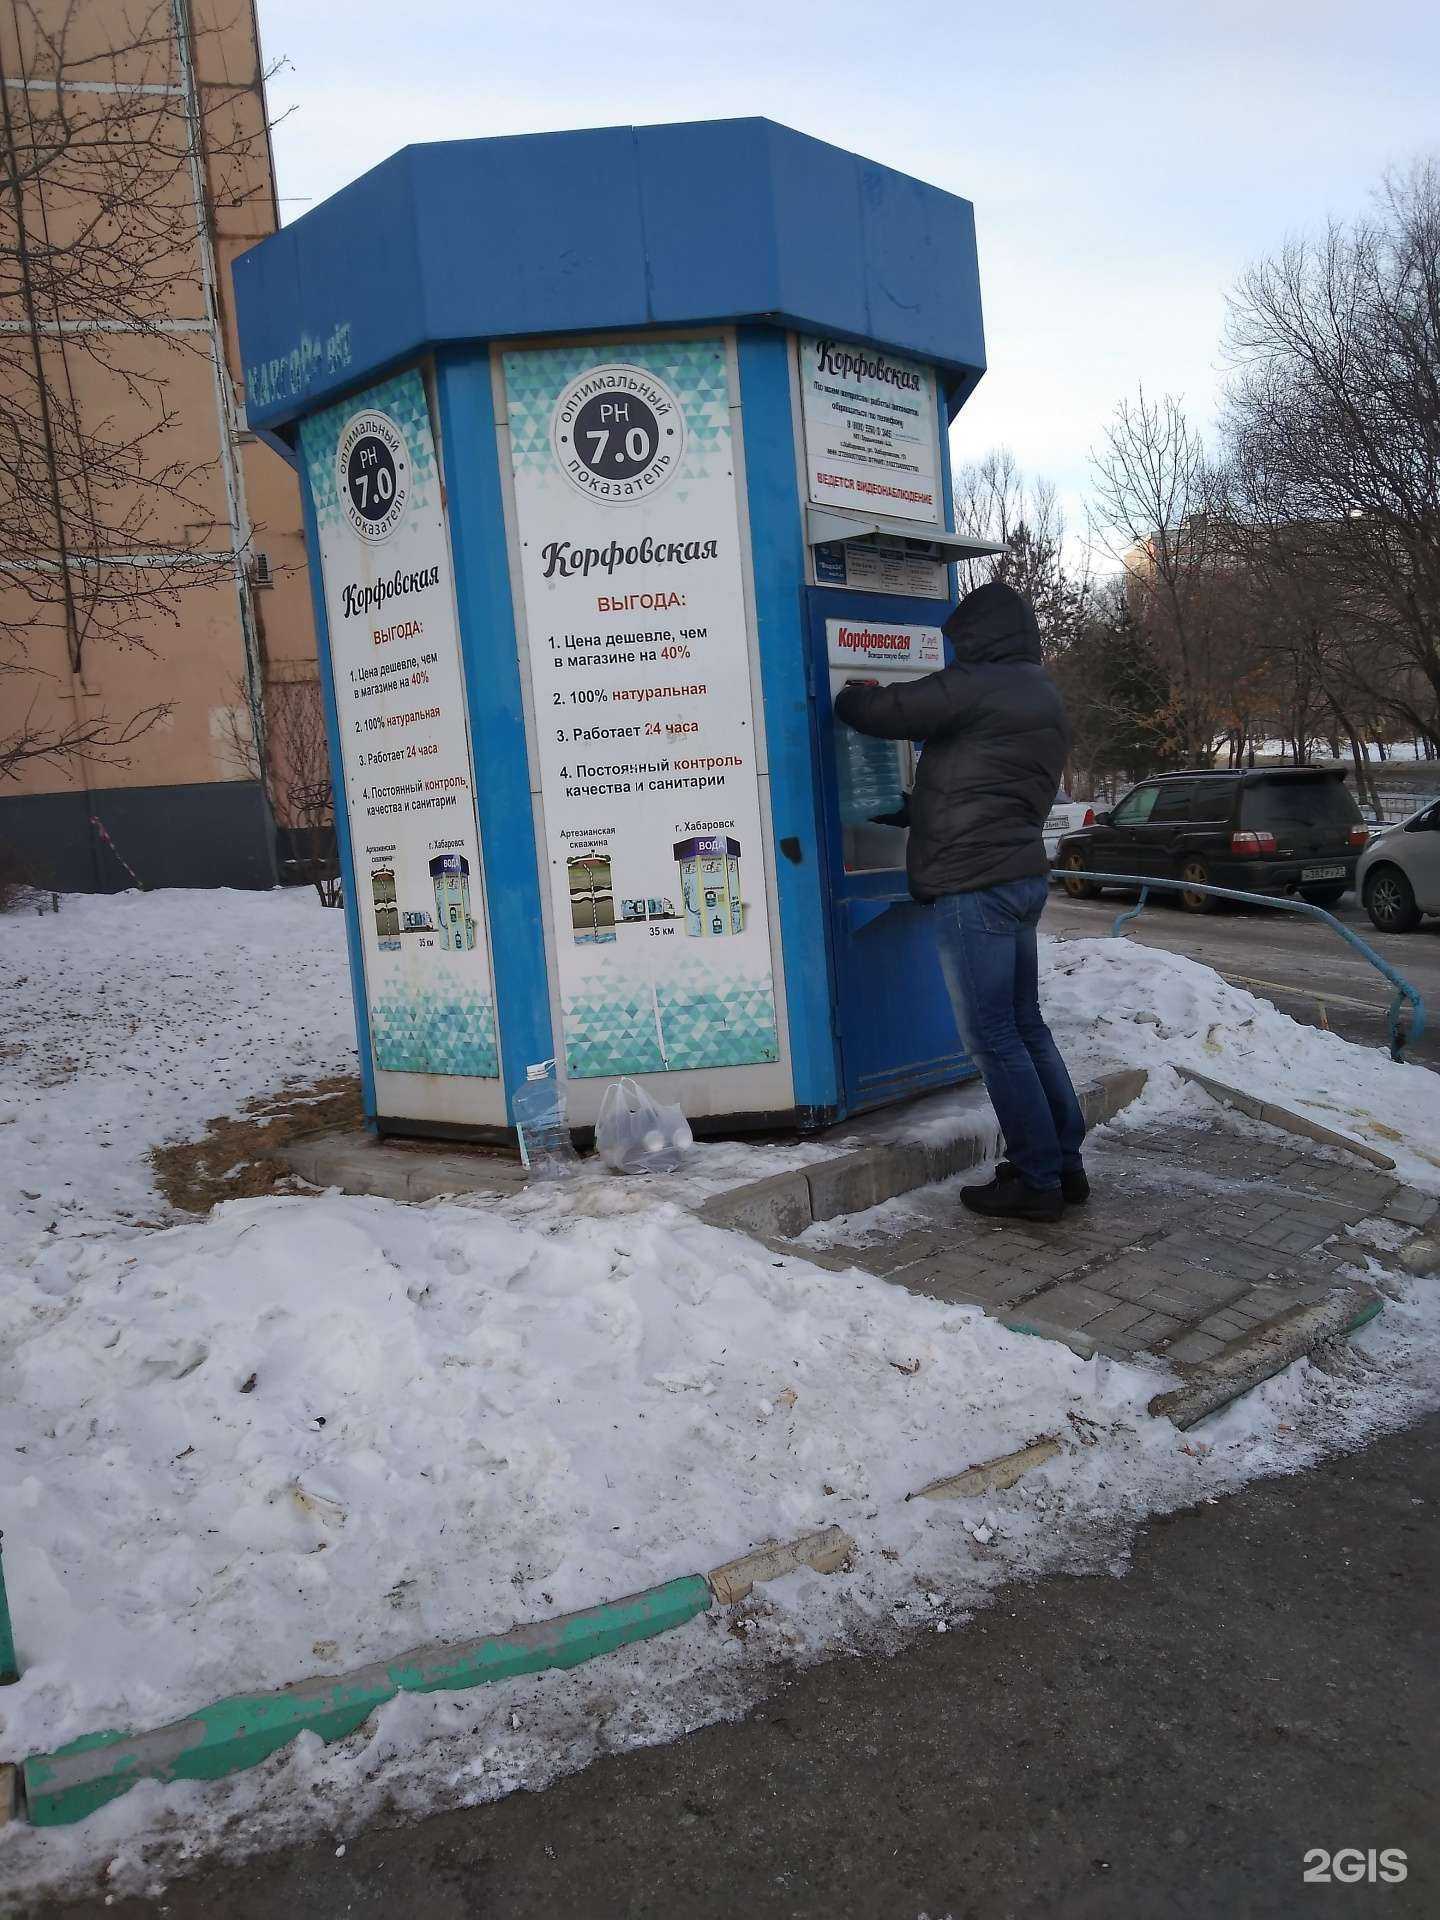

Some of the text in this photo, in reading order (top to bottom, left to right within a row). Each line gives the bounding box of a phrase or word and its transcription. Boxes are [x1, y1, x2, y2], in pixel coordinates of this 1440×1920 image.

[816, 338, 920, 391] Корфовская
[561, 375, 672, 424] оптимальный
[340, 420, 400, 474] оптимальный
[586, 427, 650, 465] 7.0
[567, 454, 671, 496] показатель
[355, 467, 393, 509] 7.0
[817, 472, 933, 505] ВЕДЕТСЯ ВИДЕОНАБЛЮДЕНИЕ
[349, 489, 406, 535] показатель
[541, 536, 718, 578] Корфовская
[342, 565, 439, 618] Корфовская
[597, 592, 686, 612] ВЫГОДА:
[373, 620, 424, 645] ВЫГОДА:
[548, 627, 708, 650] 1. Цена дешевле, чем
[838, 627, 911, 652] Корфовская
[350, 652, 438, 682] 1. Цена дешевле, чем
[554, 646, 691, 667] в магазине на 40%
[354, 670, 430, 699] в магазине на 40%
[553, 683, 707, 705] 2. 100% натуральная
[355, 707, 440, 733] 2. 100% натуральная
[556, 722, 699, 742] 3. Работает 24 часа
[359, 744, 438, 766] 3. Работает 24 часа
[560, 755, 743, 779] 4. Постоянный контроль
[363, 776, 466, 800] 4. Постоянный контроль
[566, 775, 725, 797] качества и санитарии
[367, 795, 457, 817] качества и санитарии
[559, 826, 616, 839] Артезианская
[684, 820, 735, 832] Хабаровск
[434, 839, 465, 850] Хабаровск
[569, 839, 608, 849] скважина
[698, 840, 725, 851] ВОДА
[649, 926, 675, 936] 35 км
